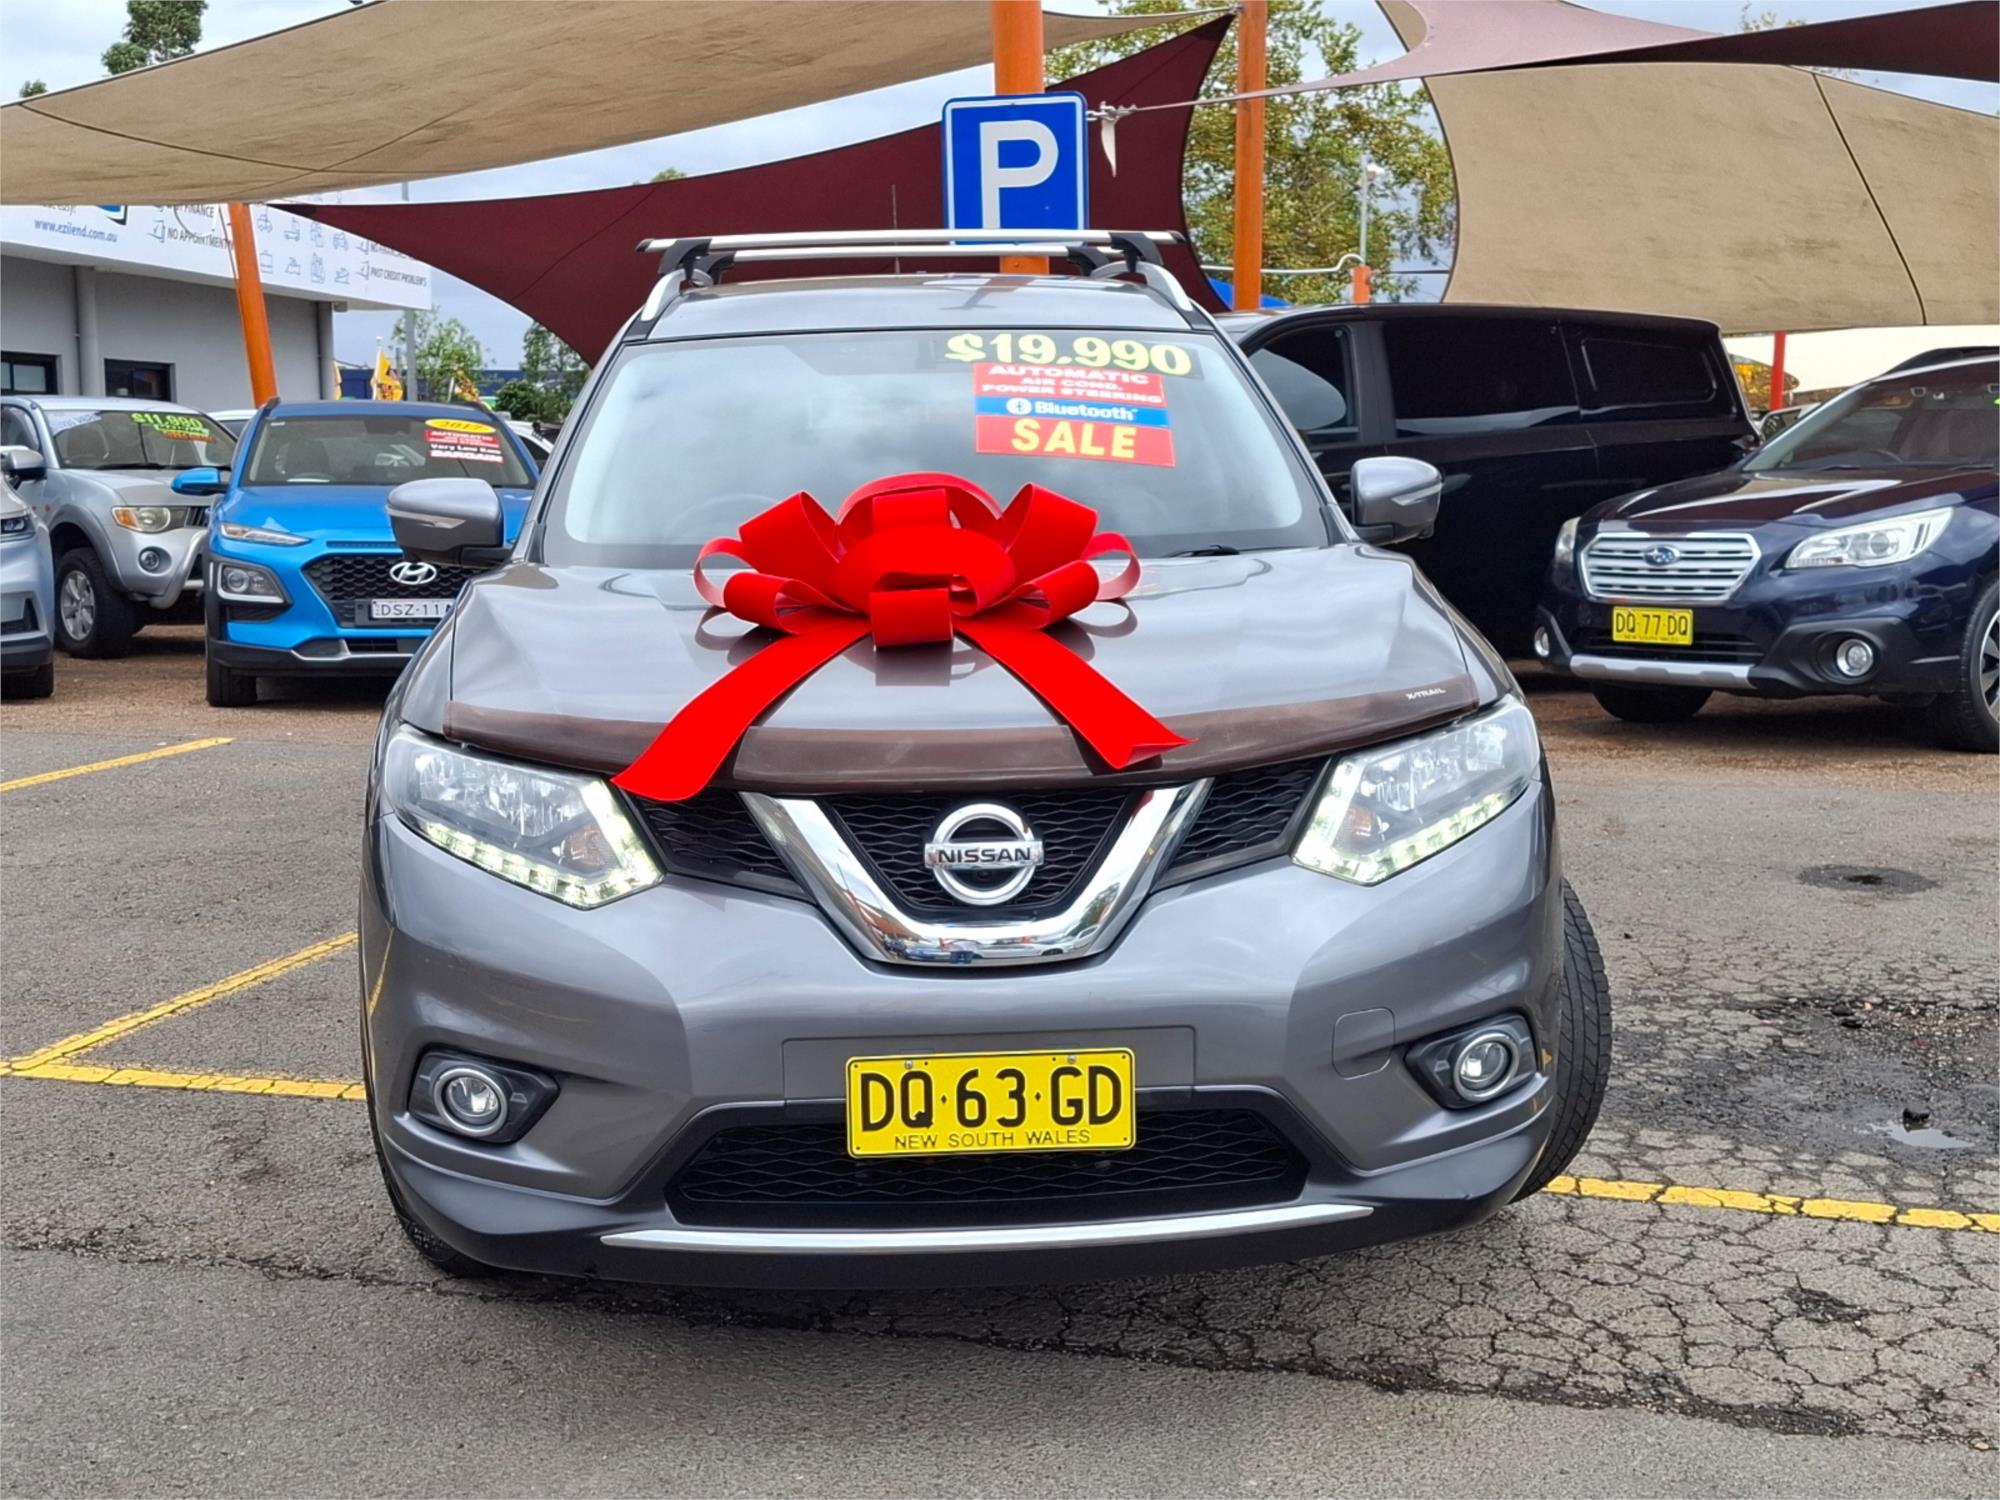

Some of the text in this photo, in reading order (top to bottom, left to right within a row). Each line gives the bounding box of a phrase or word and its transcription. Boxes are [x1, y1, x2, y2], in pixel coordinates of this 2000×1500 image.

[979, 119, 1060, 229] P
[34, 219, 118, 243] www.ezilend.com.au
[988, 364, 1150, 386] AUTOMATIC
[1020, 376, 1125, 392] AIR COND.
[981, 383, 1163, 404] POWER STEERING
[1011, 417, 1138, 459] SALE
[938, 847, 1031, 864] NISSAN
[894, 1128, 1091, 1150] NEW SOUTH WALES
